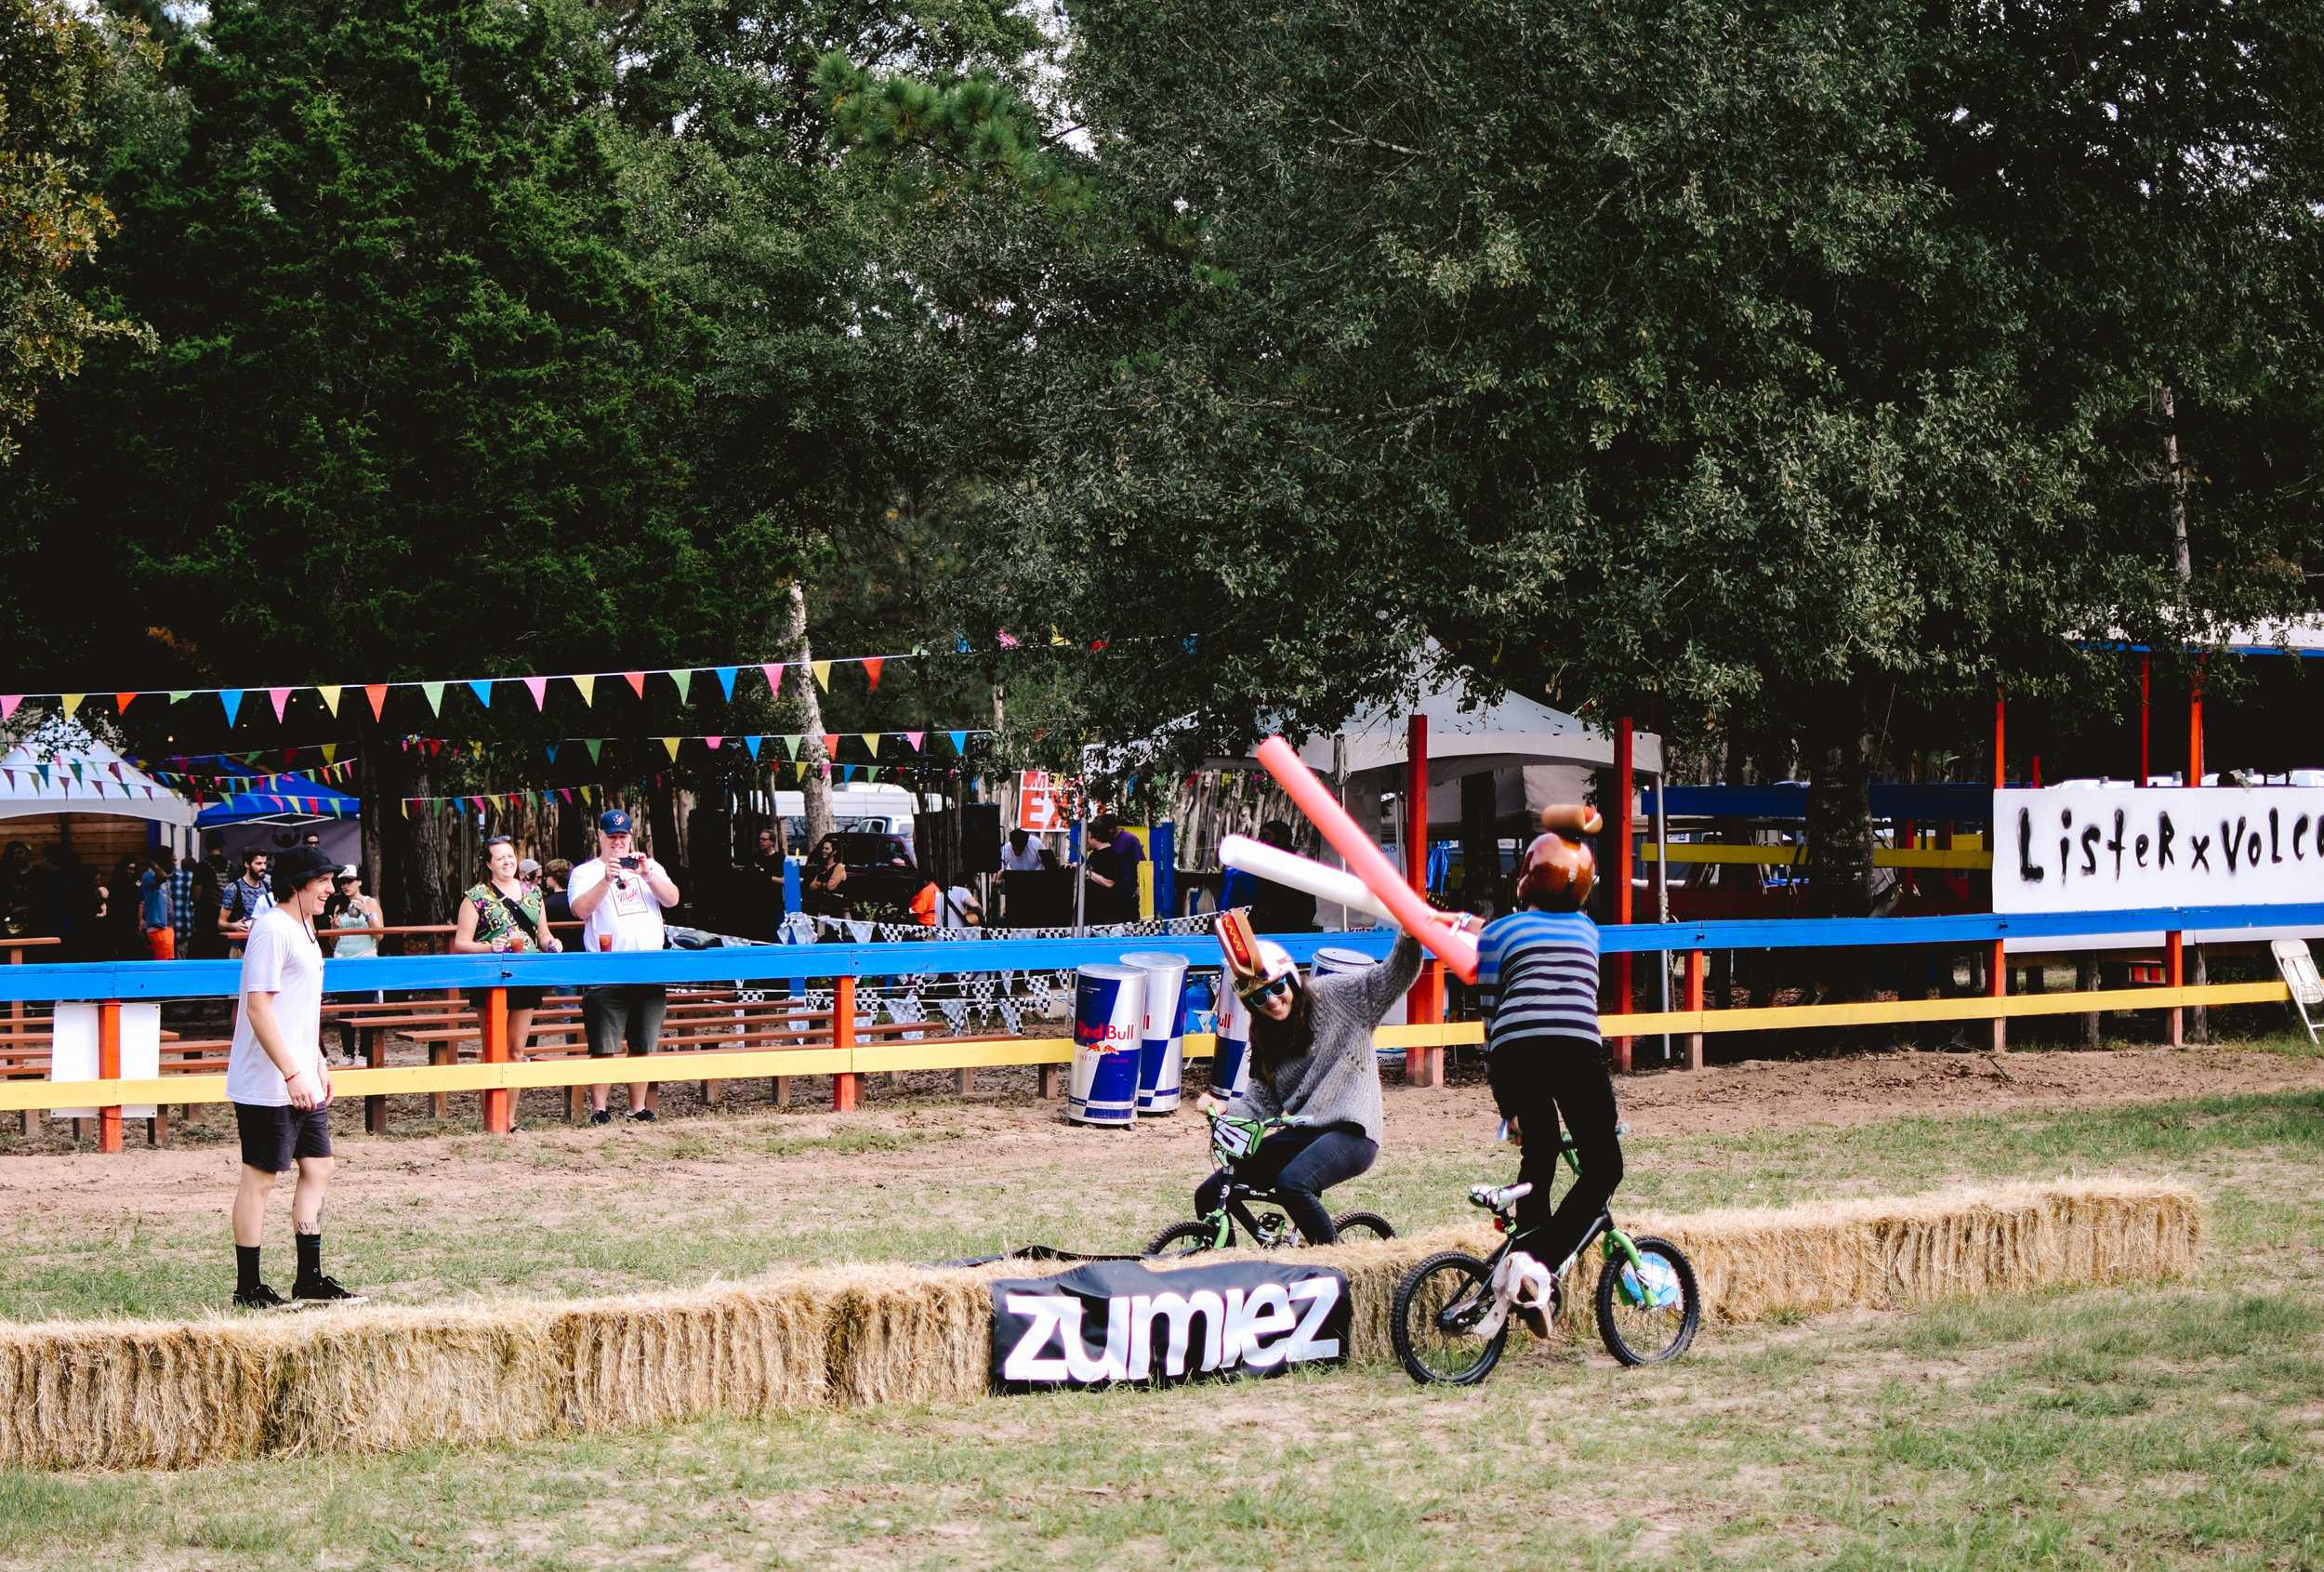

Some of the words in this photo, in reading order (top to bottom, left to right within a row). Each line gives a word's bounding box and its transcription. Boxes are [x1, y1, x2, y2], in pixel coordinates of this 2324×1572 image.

[1217, 1012, 1231, 1029] ull
[1105, 1025, 1134, 1039] Bull
[1005, 1276, 1340, 1382] zumiez
